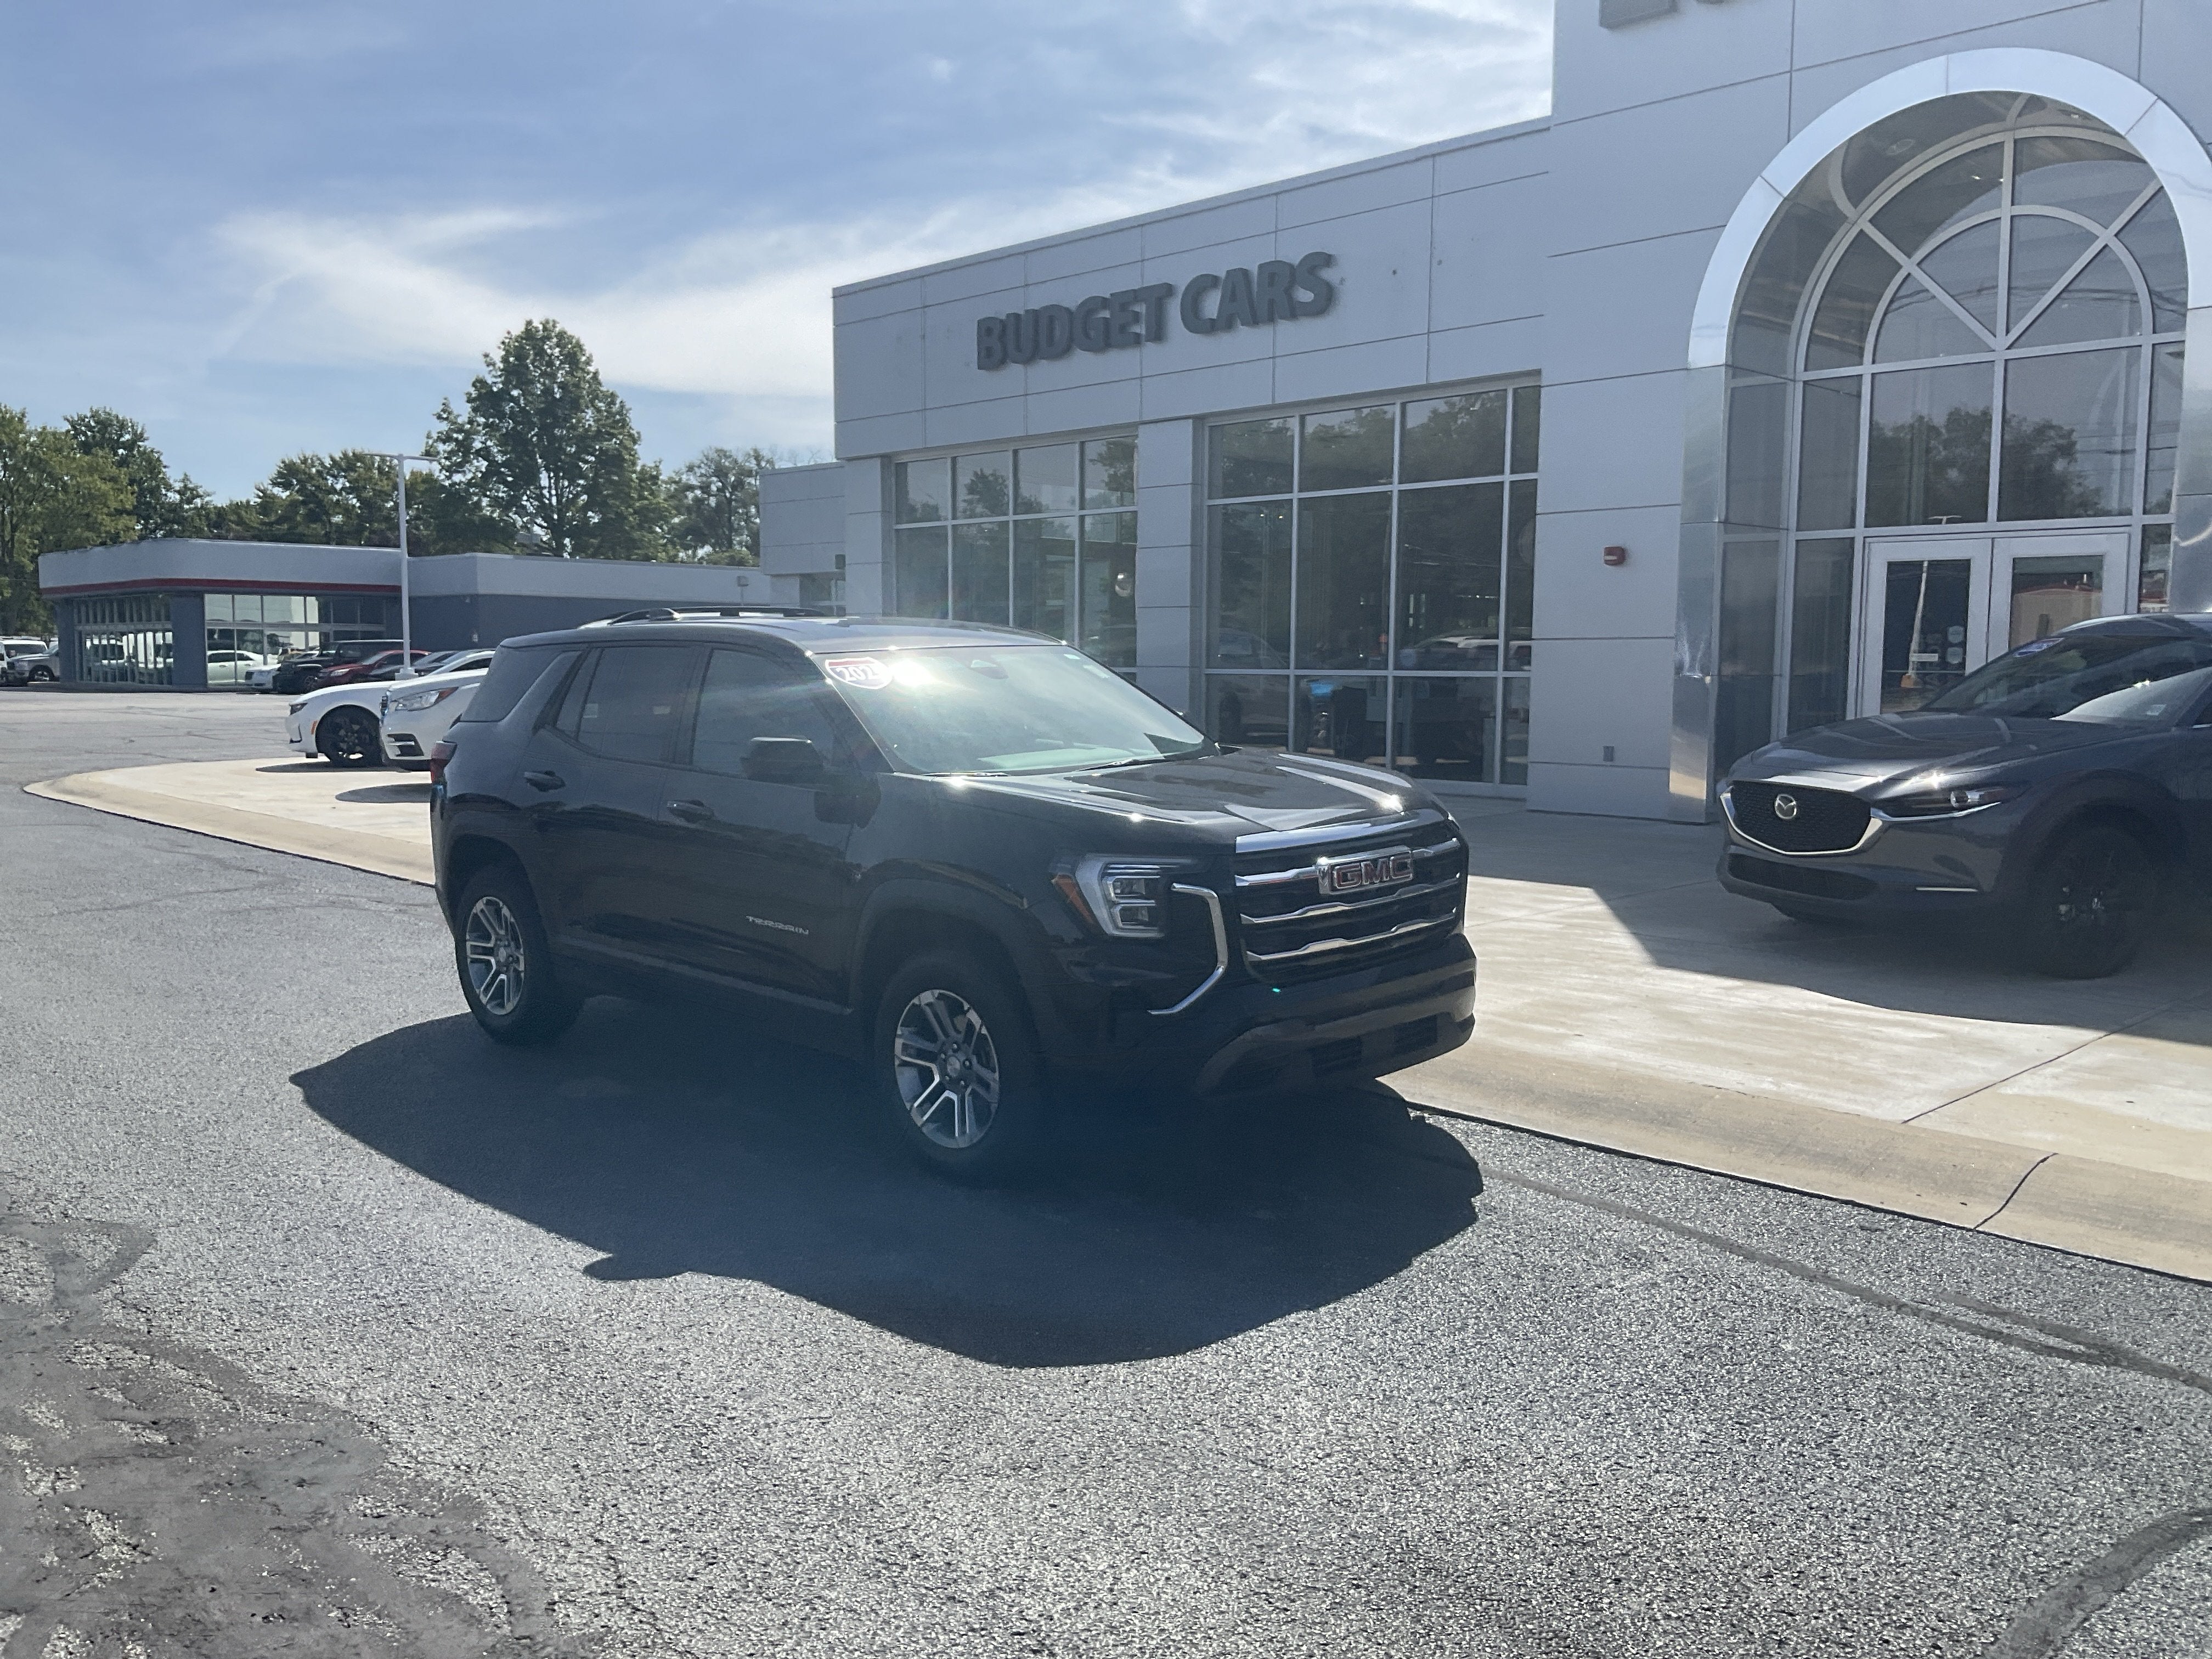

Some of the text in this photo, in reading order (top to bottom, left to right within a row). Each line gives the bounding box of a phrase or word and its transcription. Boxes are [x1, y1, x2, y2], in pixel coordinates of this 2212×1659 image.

[977, 251, 1334, 371] BUDGET CARS
[835, 665, 888, 681] 202
[1333, 850, 1413, 889] GMC
